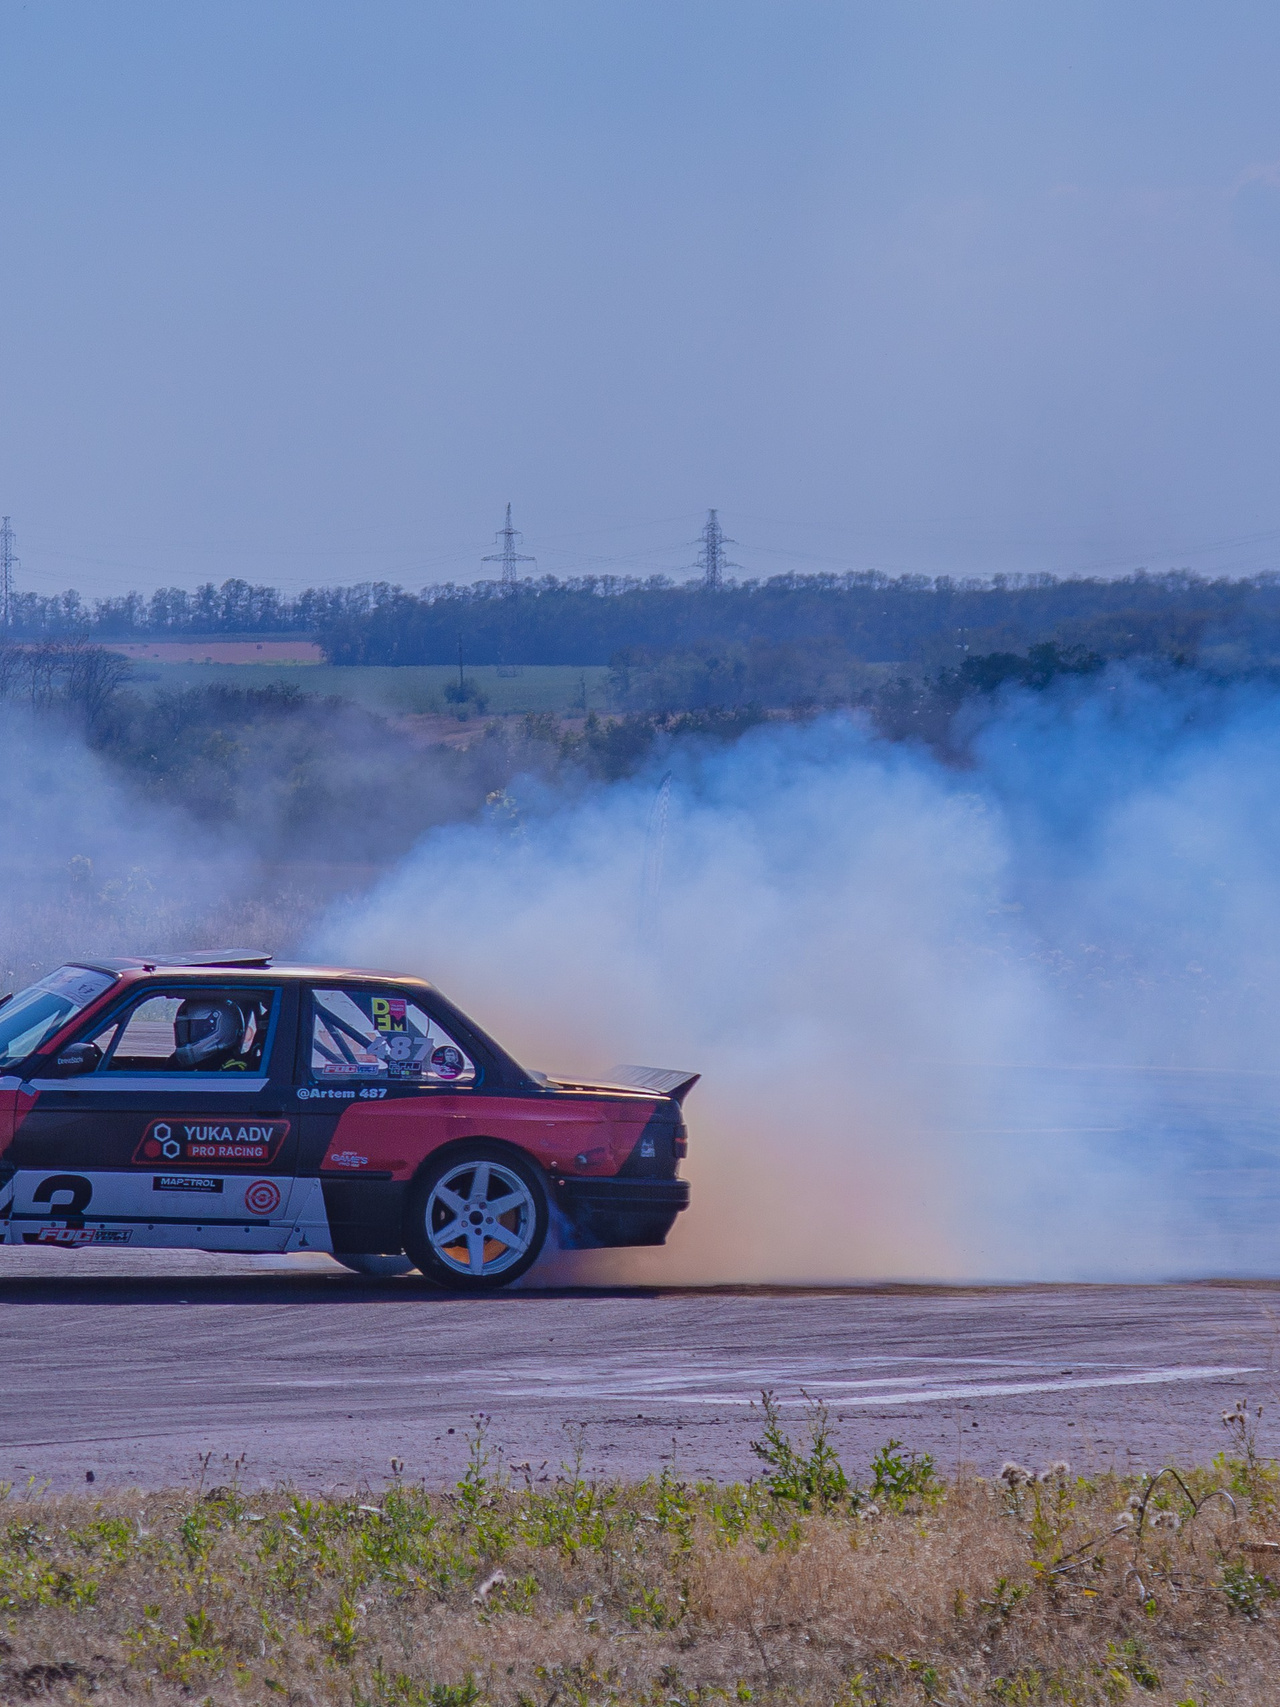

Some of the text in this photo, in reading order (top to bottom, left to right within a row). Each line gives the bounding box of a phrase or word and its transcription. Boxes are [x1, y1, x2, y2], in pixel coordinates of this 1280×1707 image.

[366, 1036, 434, 1061] 487
[297, 1088, 387, 1099] @Artem 487
[184, 1126, 274, 1142] YUKA ADV
[192, 1146, 263, 1157] PRO RACING
